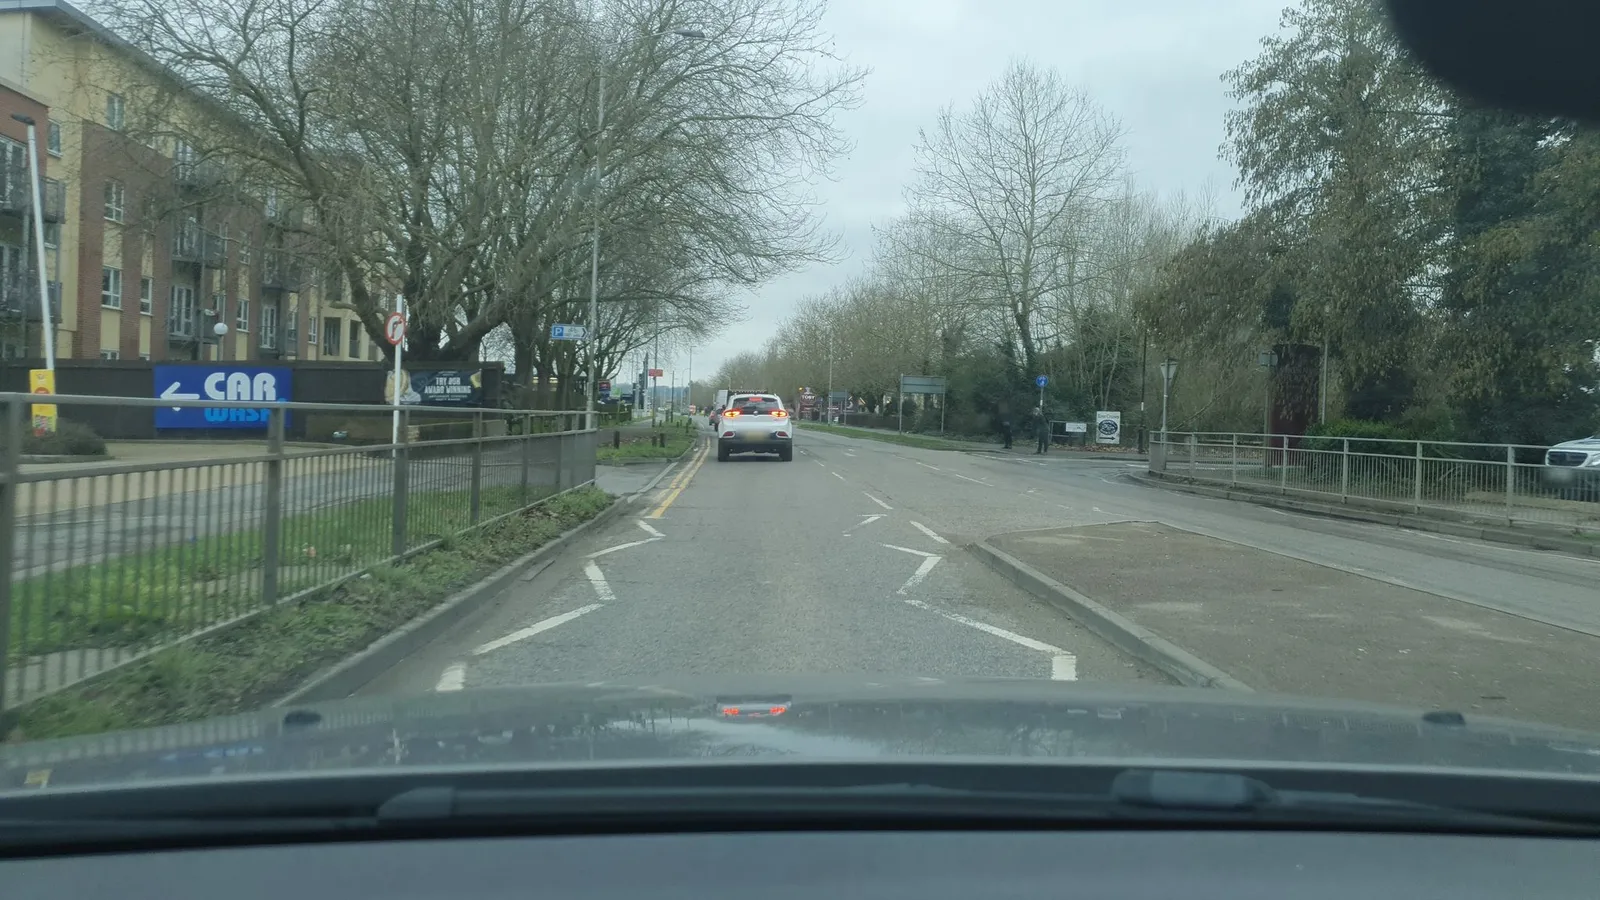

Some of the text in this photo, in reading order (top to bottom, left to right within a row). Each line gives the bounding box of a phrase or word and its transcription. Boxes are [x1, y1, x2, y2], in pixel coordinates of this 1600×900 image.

[435, 377, 447, 385] TRY
[204, 372, 277, 401] CAR
[424, 386, 471, 394] AWARD WINNING
